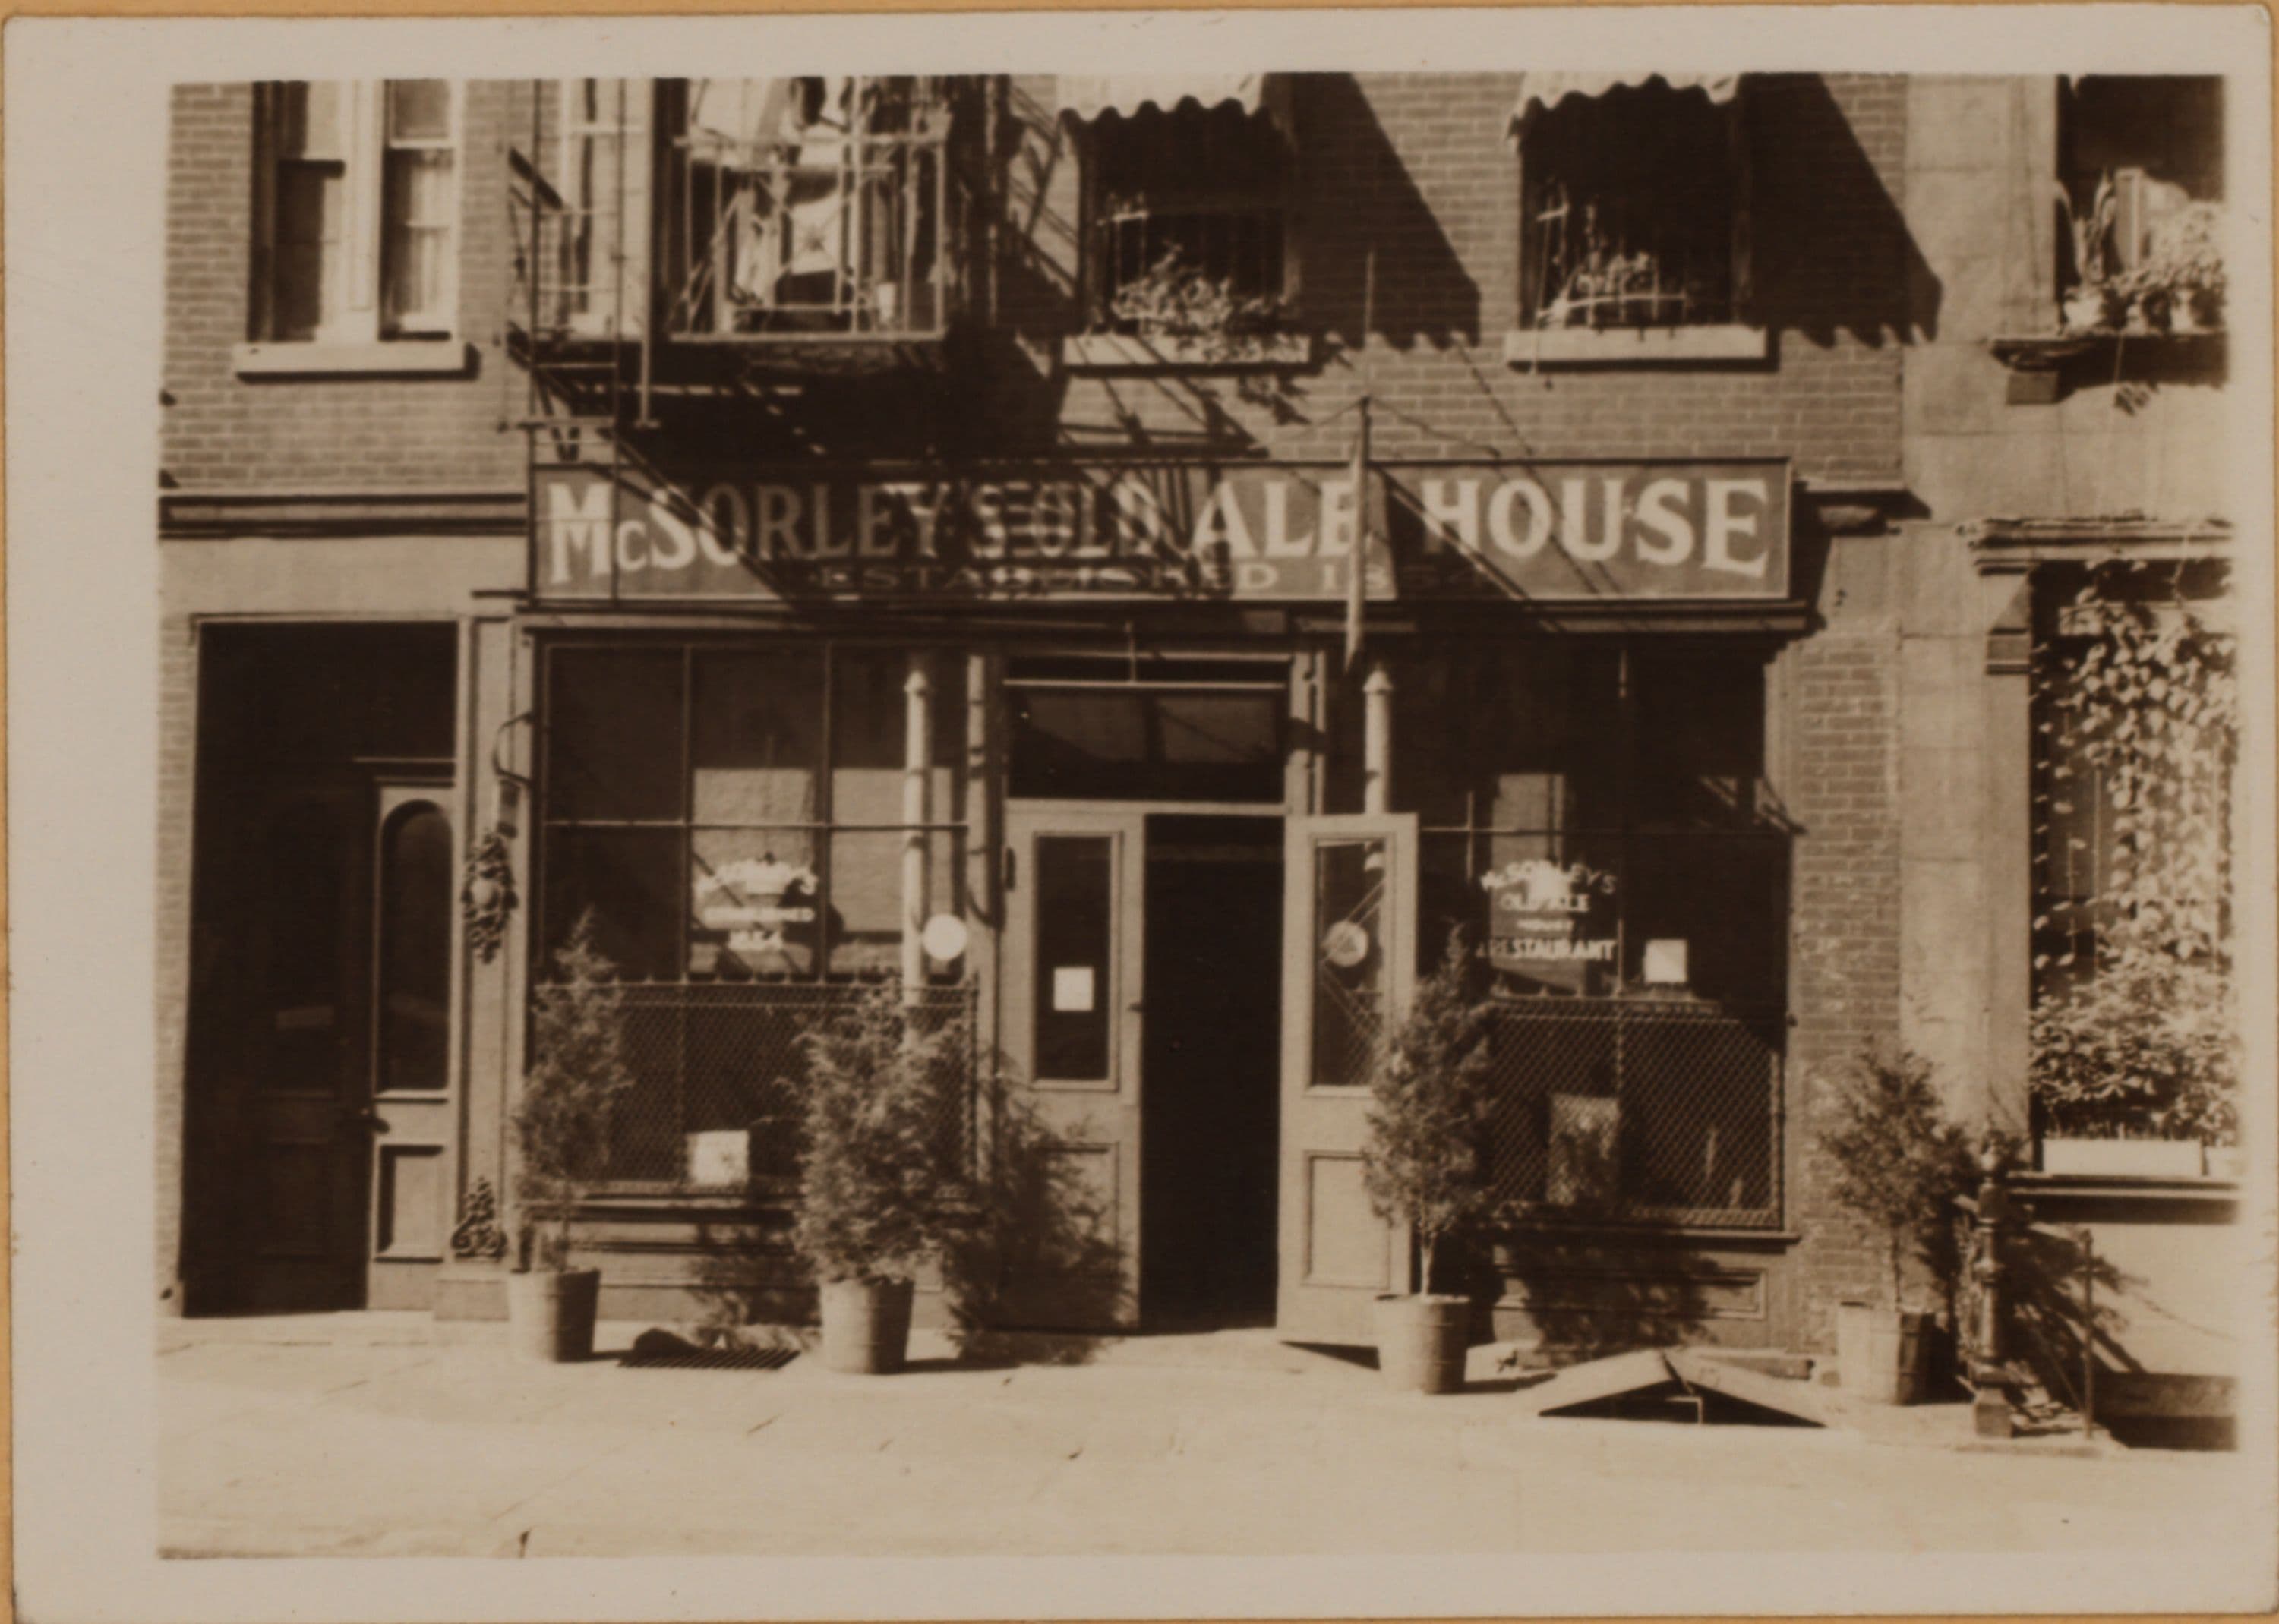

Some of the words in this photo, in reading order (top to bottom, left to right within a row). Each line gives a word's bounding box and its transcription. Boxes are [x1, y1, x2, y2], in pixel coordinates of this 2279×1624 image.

[548, 481, 1008, 584] McSORLEY'S
[1190, 480, 1373, 558] ALE
[1420, 478, 1770, 577] HOUSE
[1490, 938, 1618, 960] RESTAURANT
